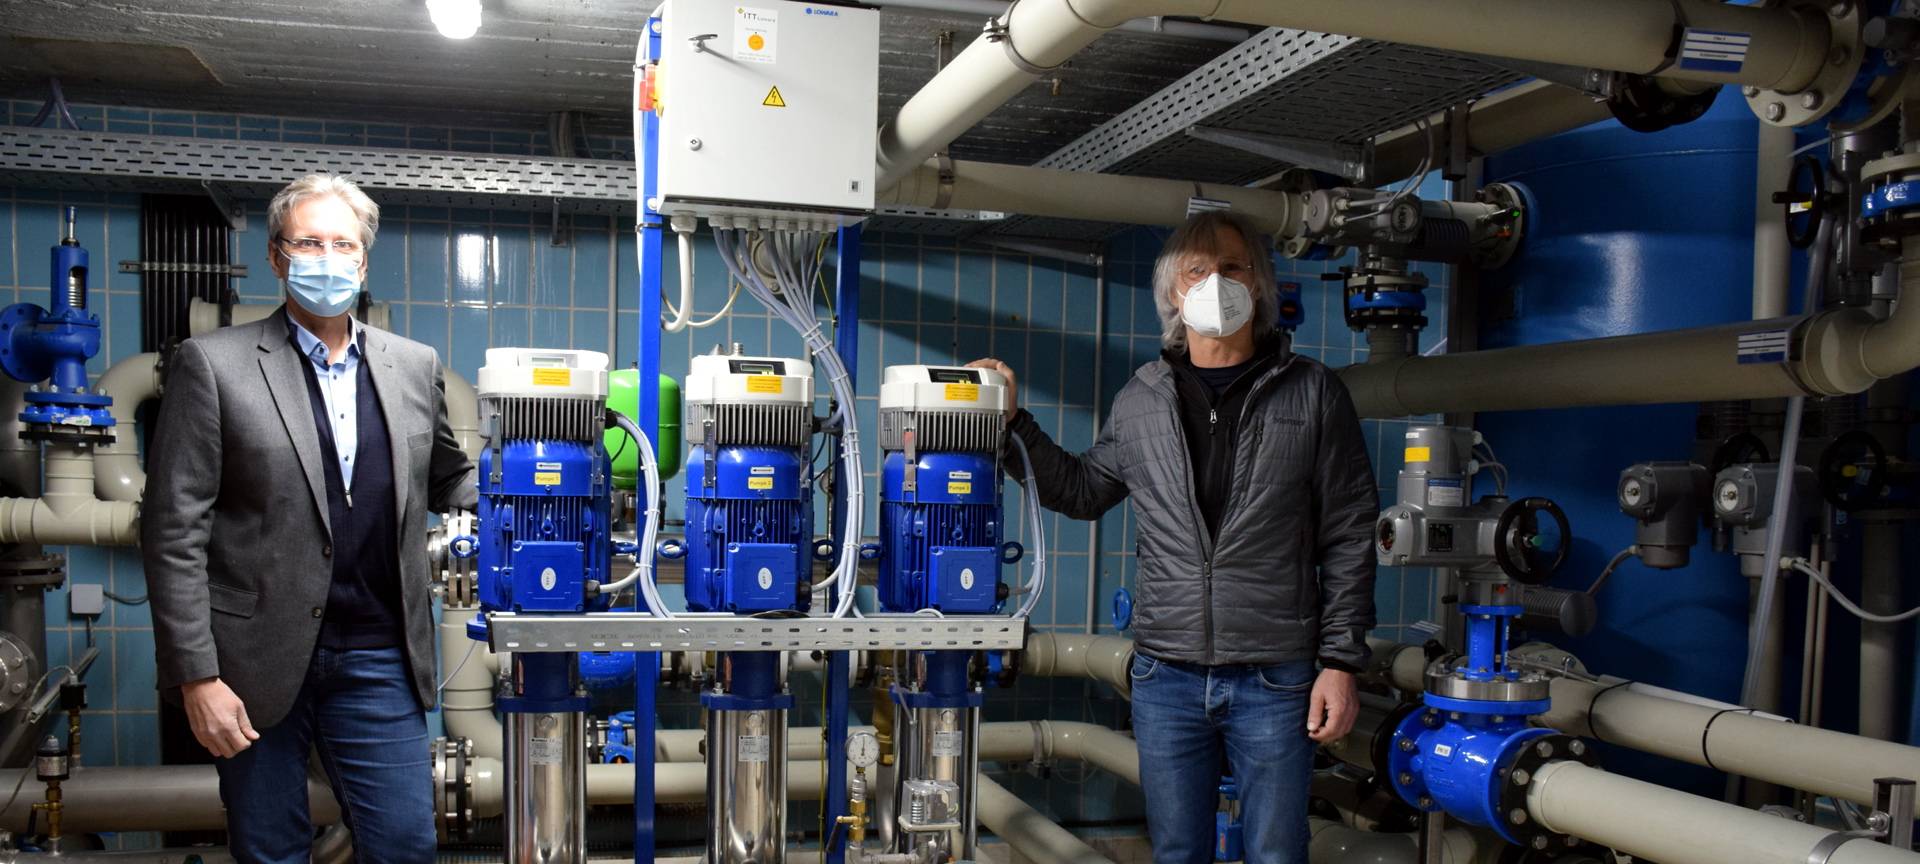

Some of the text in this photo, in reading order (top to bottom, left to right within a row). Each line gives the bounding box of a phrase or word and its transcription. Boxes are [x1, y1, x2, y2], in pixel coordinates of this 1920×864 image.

[536, 475, 555, 483] Pumpe
[749, 480, 767, 488] Pumpe
[949, 484, 966, 492] Pumpe
